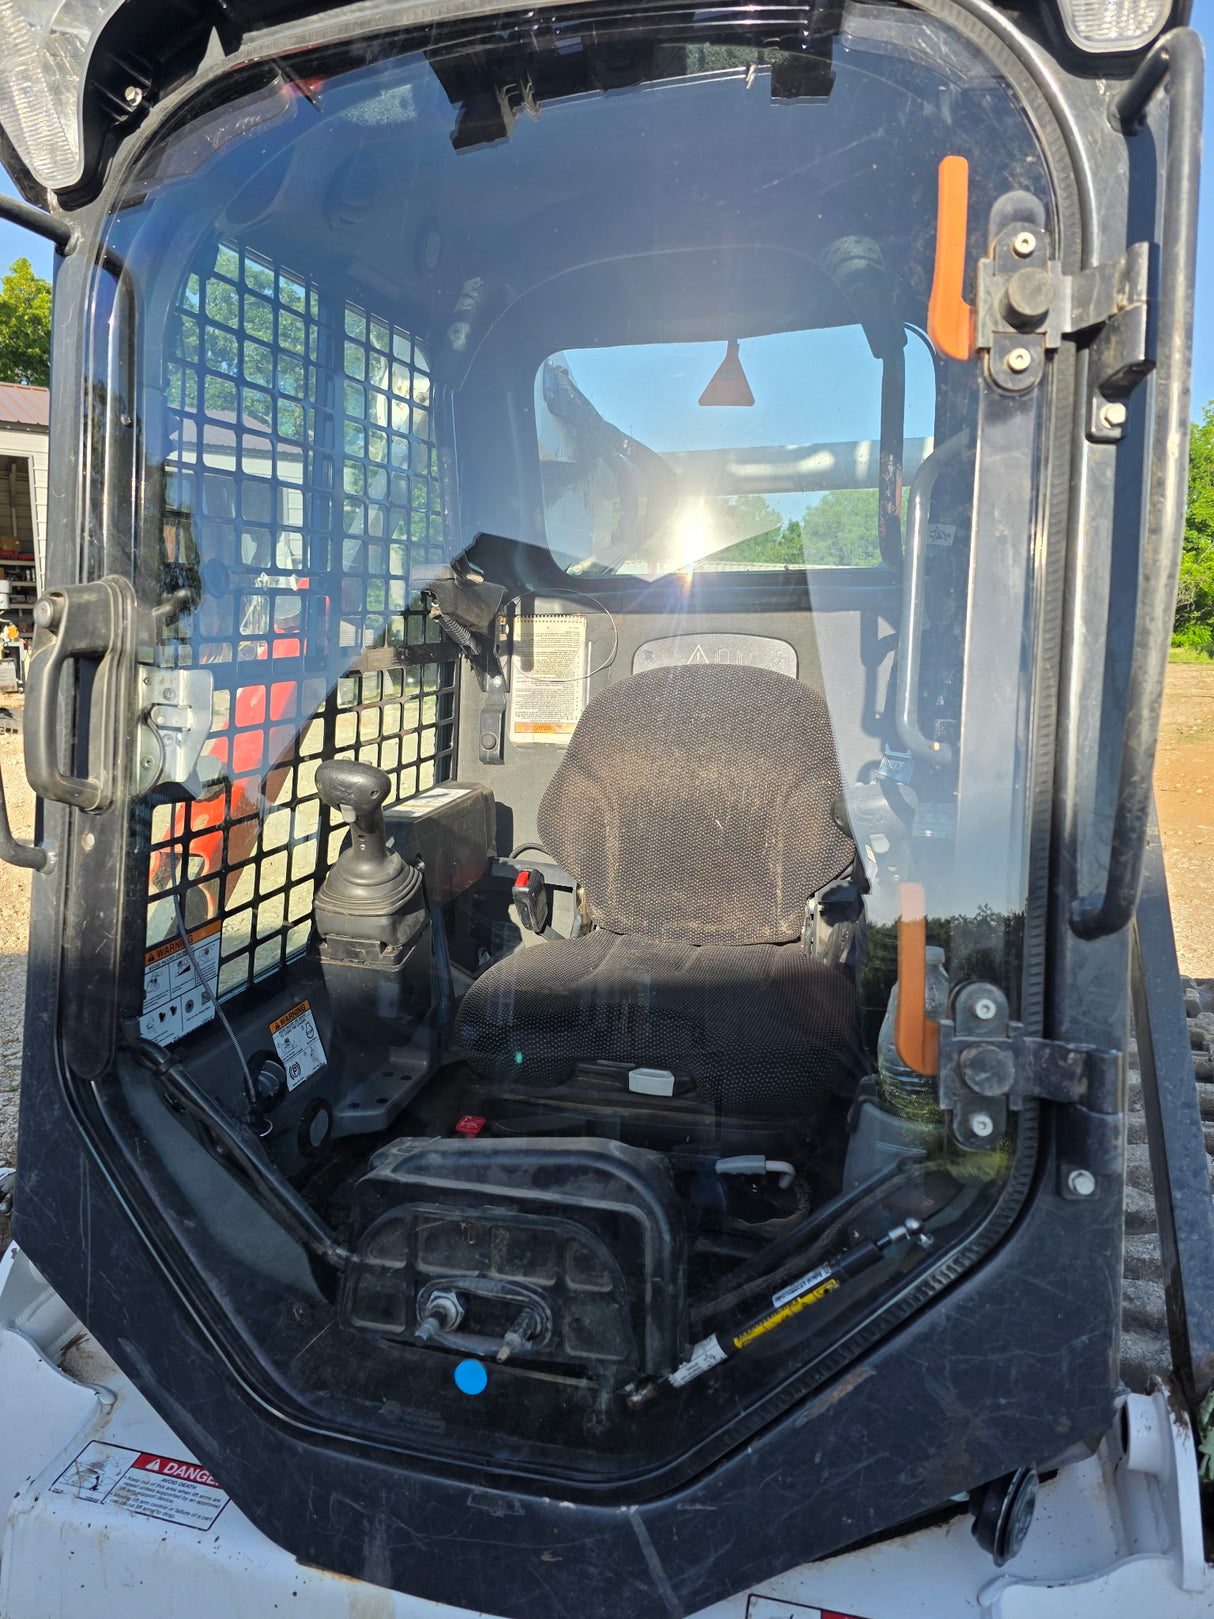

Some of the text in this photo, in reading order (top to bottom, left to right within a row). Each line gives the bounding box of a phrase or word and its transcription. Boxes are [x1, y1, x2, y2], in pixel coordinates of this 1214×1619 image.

[156, 934, 194, 957] WARNIG
[281, 1003, 306, 1027] WARNING
[126, 1475, 141, 1484] Keep
[163, 1462, 219, 1486] DANGE
[161, 1477, 198, 1490] AVOID DEATH
[155, 1489, 182, 1499] supported
